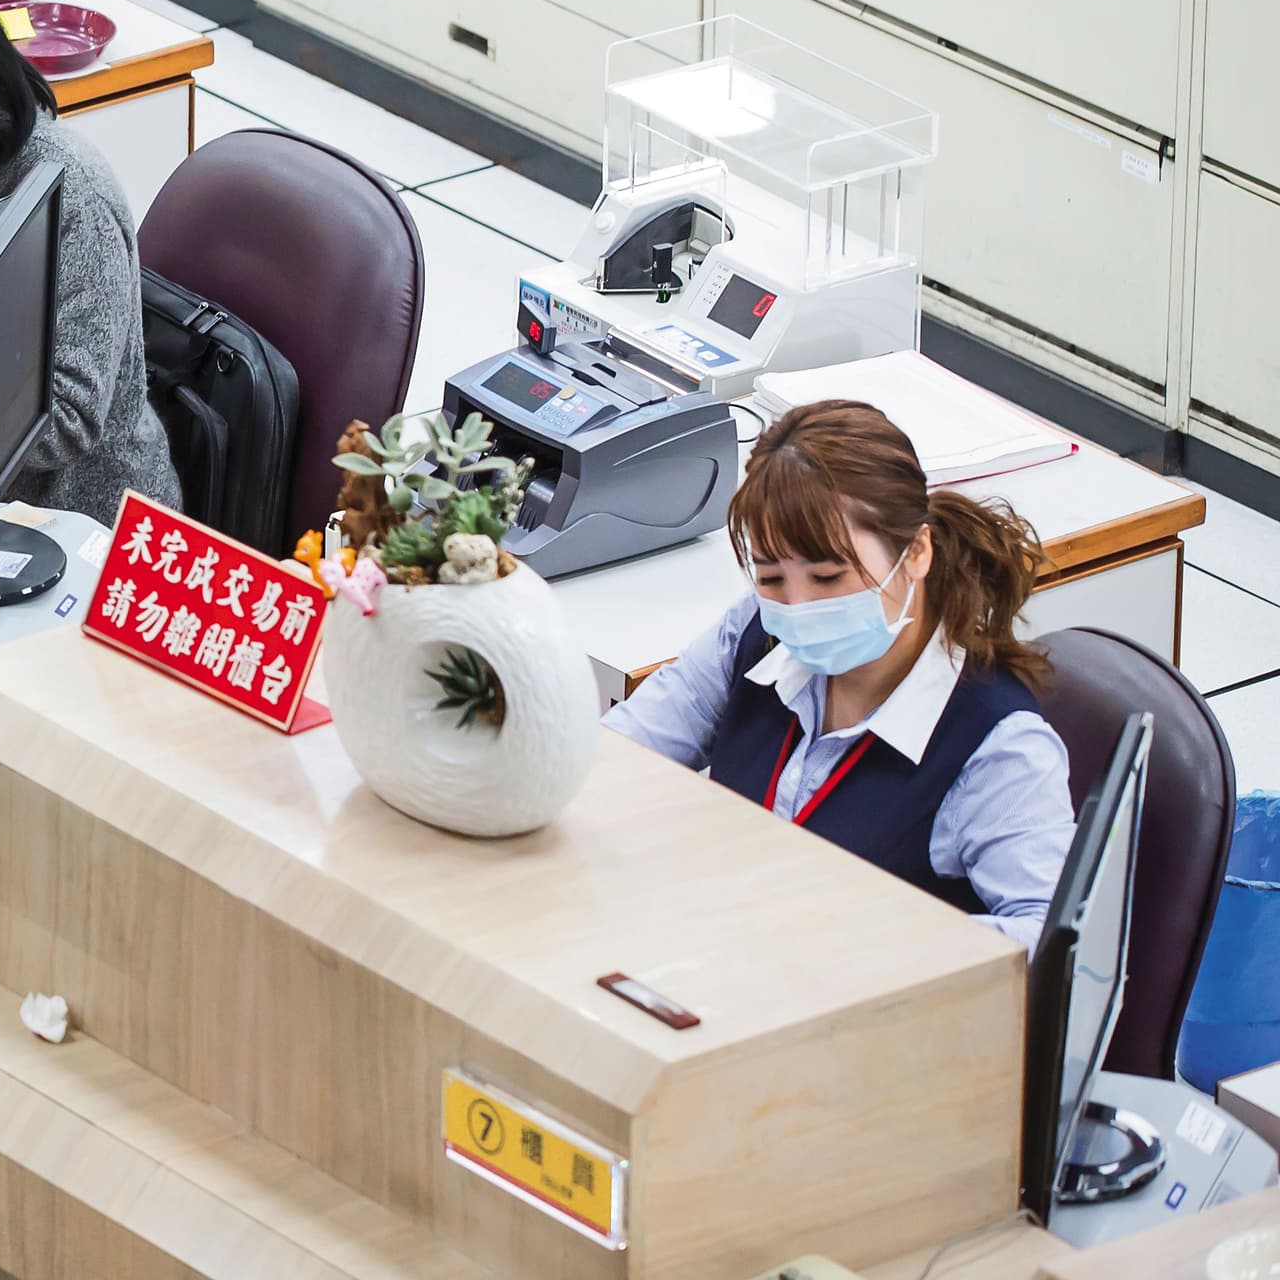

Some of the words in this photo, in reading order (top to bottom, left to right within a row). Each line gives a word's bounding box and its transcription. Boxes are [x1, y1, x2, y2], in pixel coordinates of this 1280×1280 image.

[752, 293, 777, 318] 0
[101, 577, 293, 705] 請勿離開櫃台
[121, 516, 317, 646] 未完成交易前
